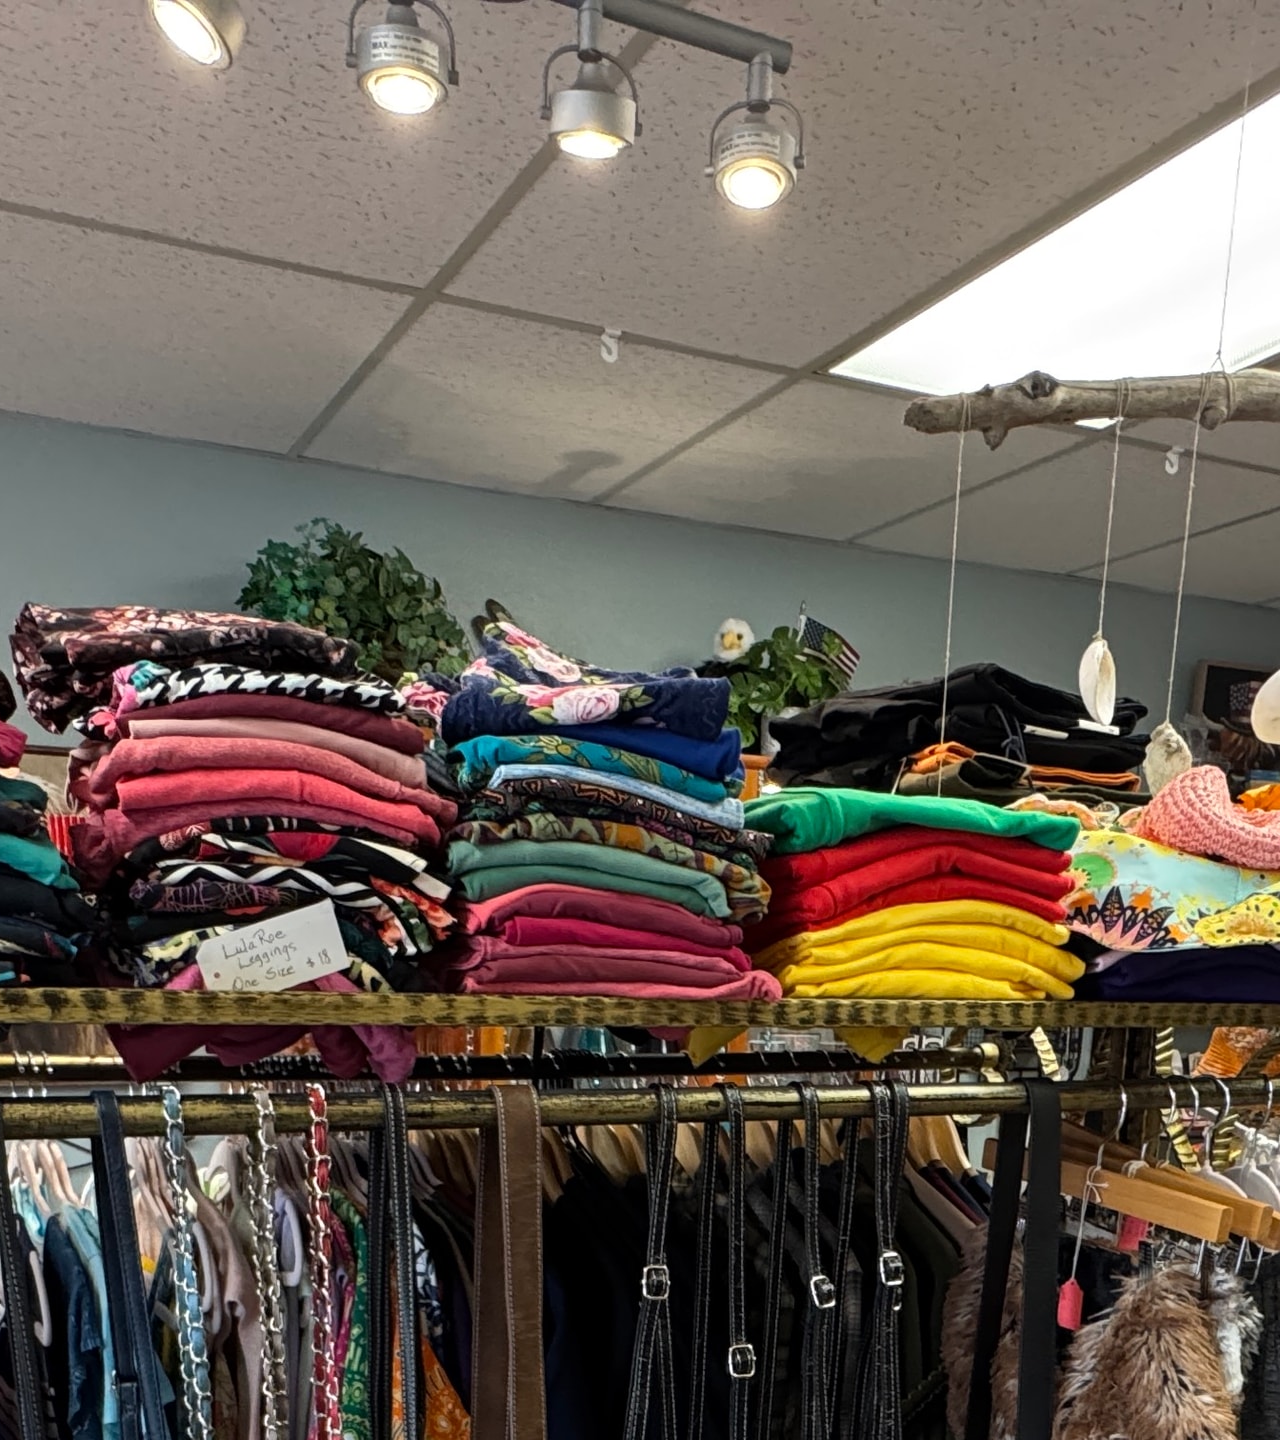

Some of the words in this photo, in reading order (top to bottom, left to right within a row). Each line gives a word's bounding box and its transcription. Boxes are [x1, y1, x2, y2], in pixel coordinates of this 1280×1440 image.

[237, 942, 297, 970] Leggings
[232, 976, 260, 991] One
[264, 963, 296, 981] Size
